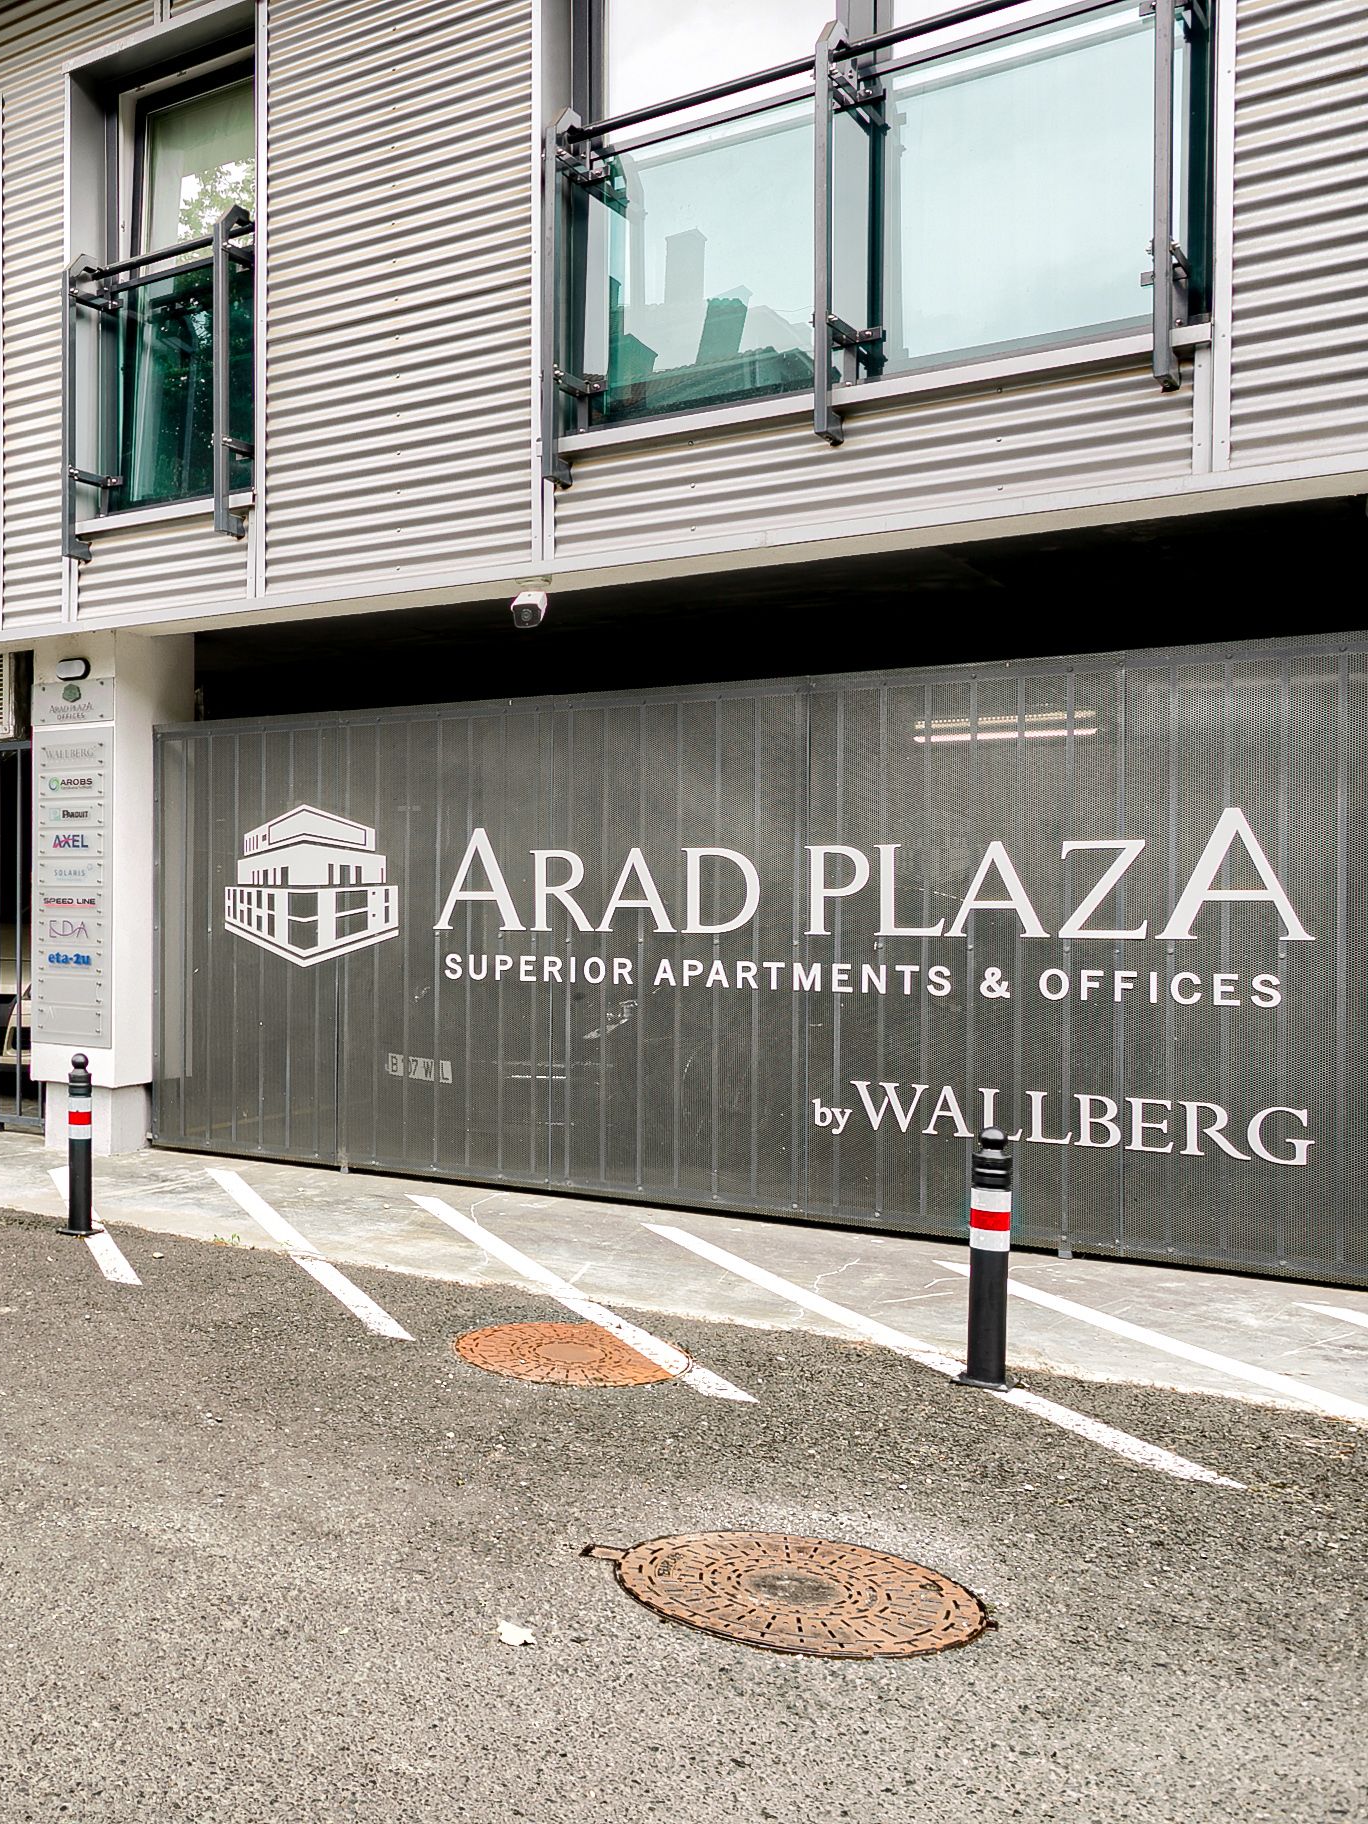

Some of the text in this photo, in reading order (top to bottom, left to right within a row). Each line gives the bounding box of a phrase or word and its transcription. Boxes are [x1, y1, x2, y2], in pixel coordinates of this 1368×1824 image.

[60, 778, 93, 786] AROBS
[52, 834, 89, 848] AXEL
[54, 869, 85, 877] SOLARIS
[433, 807, 1316, 941] ARAD PLAZA
[43, 897, 73, 905] SPEED
[49, 920, 88, 938] EDA
[48, 952, 91, 965] eta-2u
[444, 954, 1283, 1008] SUPERIOR APARTMENTS & OFFICES
[814, 1080, 1316, 1166] by WALLBERG
